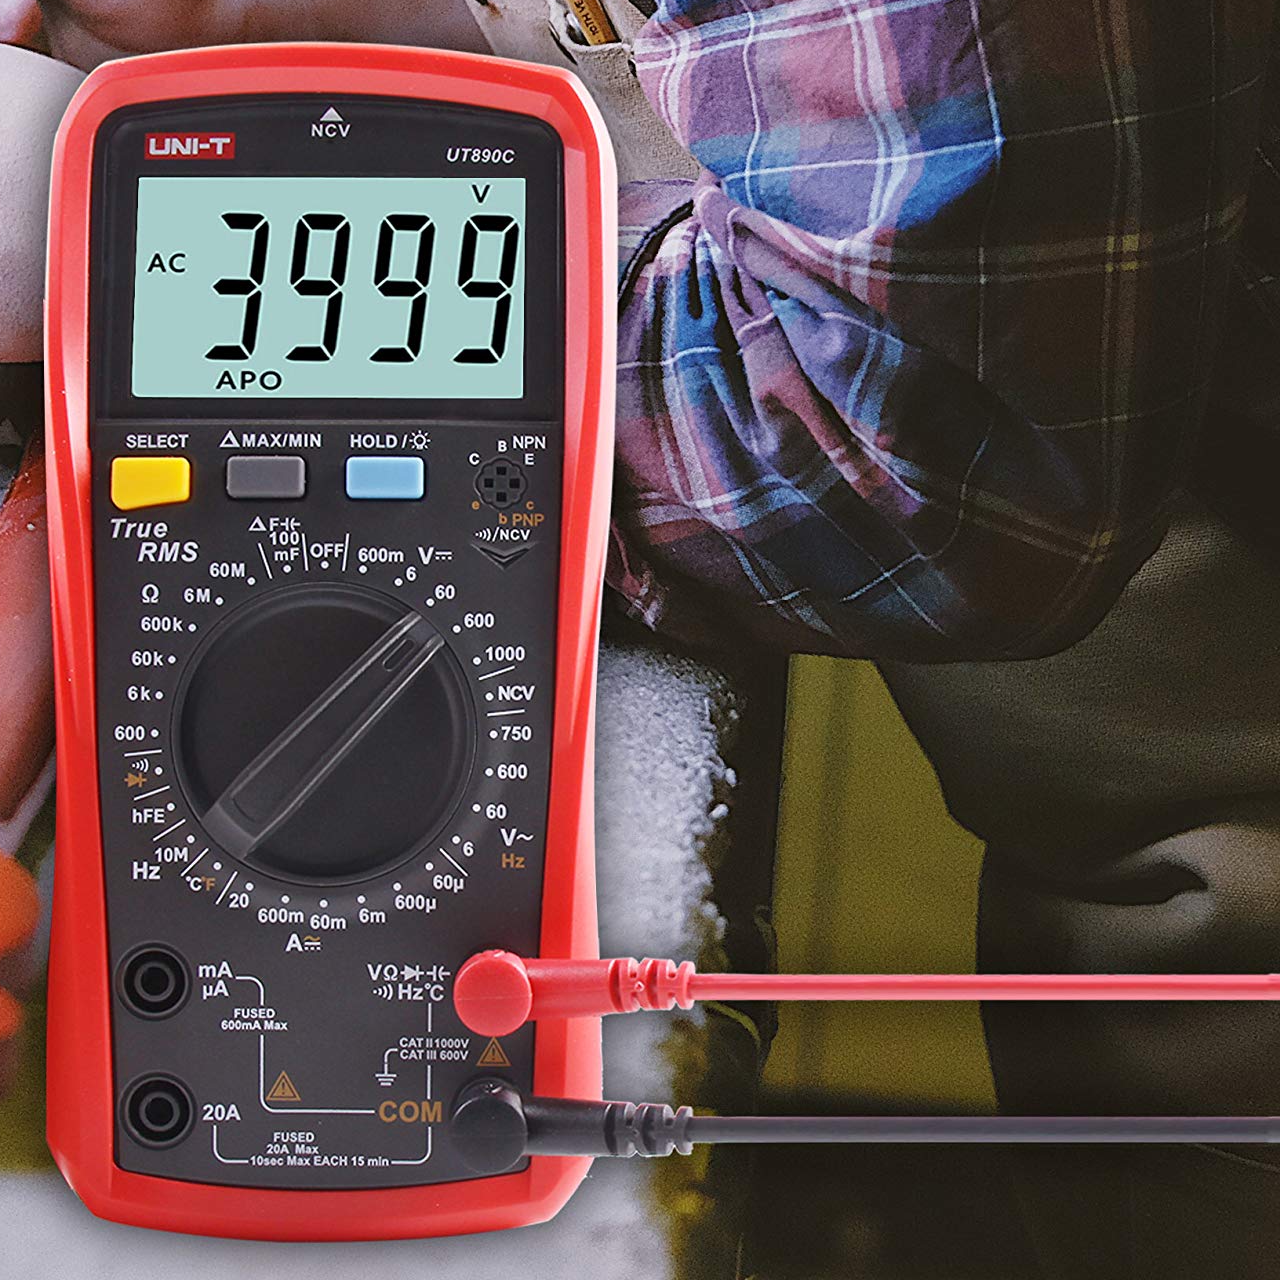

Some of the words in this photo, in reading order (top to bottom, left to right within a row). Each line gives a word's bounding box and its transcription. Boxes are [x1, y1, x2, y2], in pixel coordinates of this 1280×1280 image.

[311, 123, 351, 138] NCV
[148, 137, 231, 156] UNI-T
[446, 147, 515, 164] UT890C
[471, 184, 491, 203] V
[147, 253, 186, 273] AC
[204, 212, 520, 364] 3999
[215, 370, 282, 391] APO
[126, 433, 189, 449] SELECT
[498, 440, 507, 453] B
[512, 435, 546, 450] NPN
[468, 452, 480, 466] C
[524, 453, 535, 466] E
[498, 512, 508, 525] b
[512, 513, 545, 527] PNP
[110, 518, 169, 539] True
[269, 531, 300, 546] 100
[137, 541, 199, 562] RMS
[274, 547, 300, 561] mF
[309, 543, 344, 558] OFF
[358, 547, 404, 563] 600m
[209, 563, 245, 578] 60M
[406, 566, 417, 581] 6
[141, 583, 160, 604] Ω
[183, 587, 211, 603] 6M
[434, 584, 456, 600] 60
[140, 617, 183, 632] 600k
[463, 613, 495, 628] 600
[131, 650, 164, 666] 60k
[484, 646, 526, 661] 1000
[127, 685, 151, 701] 6k
[497, 685, 535, 701] NCV
[114, 725, 145, 741] 600
[501, 725, 532, 741] 750
[497, 764, 528, 780] 600
[132, 808, 165, 823] hFE
[485, 804, 507, 819] 60
[154, 847, 189, 863] 10M
[462, 841, 475, 857] 6
[501, 853, 525, 869] Hz
[132, 861, 161, 880] Hz
[228, 893, 250, 908] 20
[257, 908, 304, 923] 600m
[310, 914, 347, 930] 60m
[359, 908, 386, 923] 6m
[198, 961, 234, 978] mA
[233, 1008, 275, 1019] FUSED
[221, 1020, 262, 1031] 600mA
[264, 1020, 288, 1031] Max
[399, 1037, 423, 1048] CAT
[434, 1038, 470, 1048] 1000V
[399, 1050, 423, 1060] CAT
[426, 1050, 437, 1060] III
[440, 1050, 469, 1060] 600V
[202, 1104, 241, 1121] 20A
[378, 1100, 443, 1123] COM
[273, 1132, 315, 1142] FUSED
[266, 1144, 290, 1154] 20A
[295, 1144, 319, 1154] Max
[250, 1155, 283, 1166] 10sec
[286, 1155, 311, 1166] Max
[314, 1155, 348, 1166] EACH
[351, 1156, 364, 1166] 15
[367, 1156, 390, 1167] min
